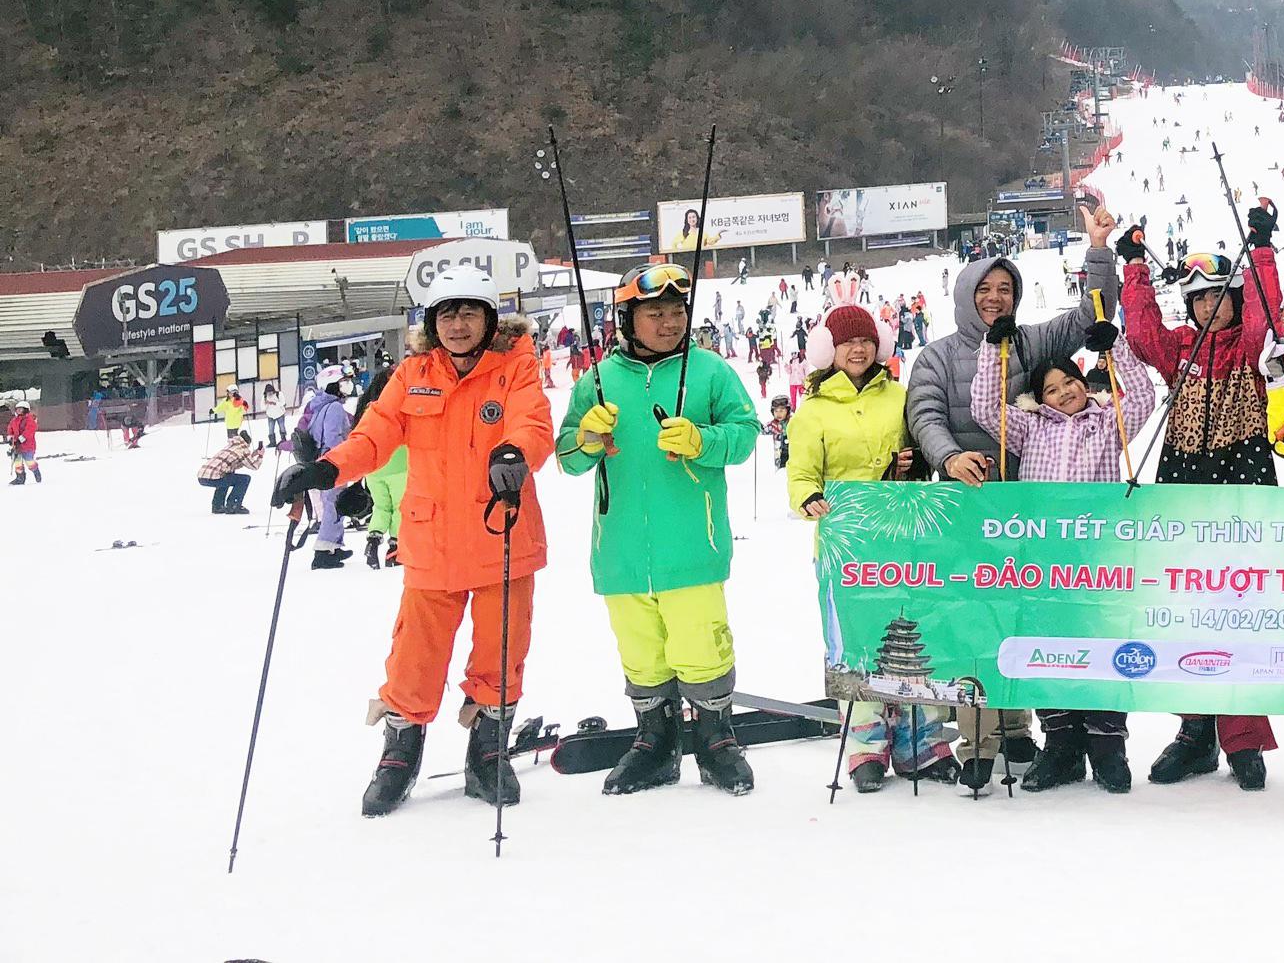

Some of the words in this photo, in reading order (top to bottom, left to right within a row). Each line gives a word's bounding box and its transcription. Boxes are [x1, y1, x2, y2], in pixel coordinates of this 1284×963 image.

[889, 200, 918, 211] XIAN
[465, 220, 484, 230] am
[465, 227, 493, 236] your
[112, 277, 198, 323] GS25
[122, 328, 156, 341] Lfestyle
[158, 323, 191, 335] Platform
[981, 513, 1047, 539] ĐÓN
[1056, 513, 1107, 540] TẾT
[1114, 515, 1185, 541] GIÁP
[1192, 516, 1263, 543] THÌN
[841, 561, 944, 587] SEOUL
[973, 556, 1043, 589] ĐẢO
[1050, 564, 1134, 590] NAMI
[1163, 565, 1269, 598] TRƯỢT
[1145, 608, 1171, 627] 10
